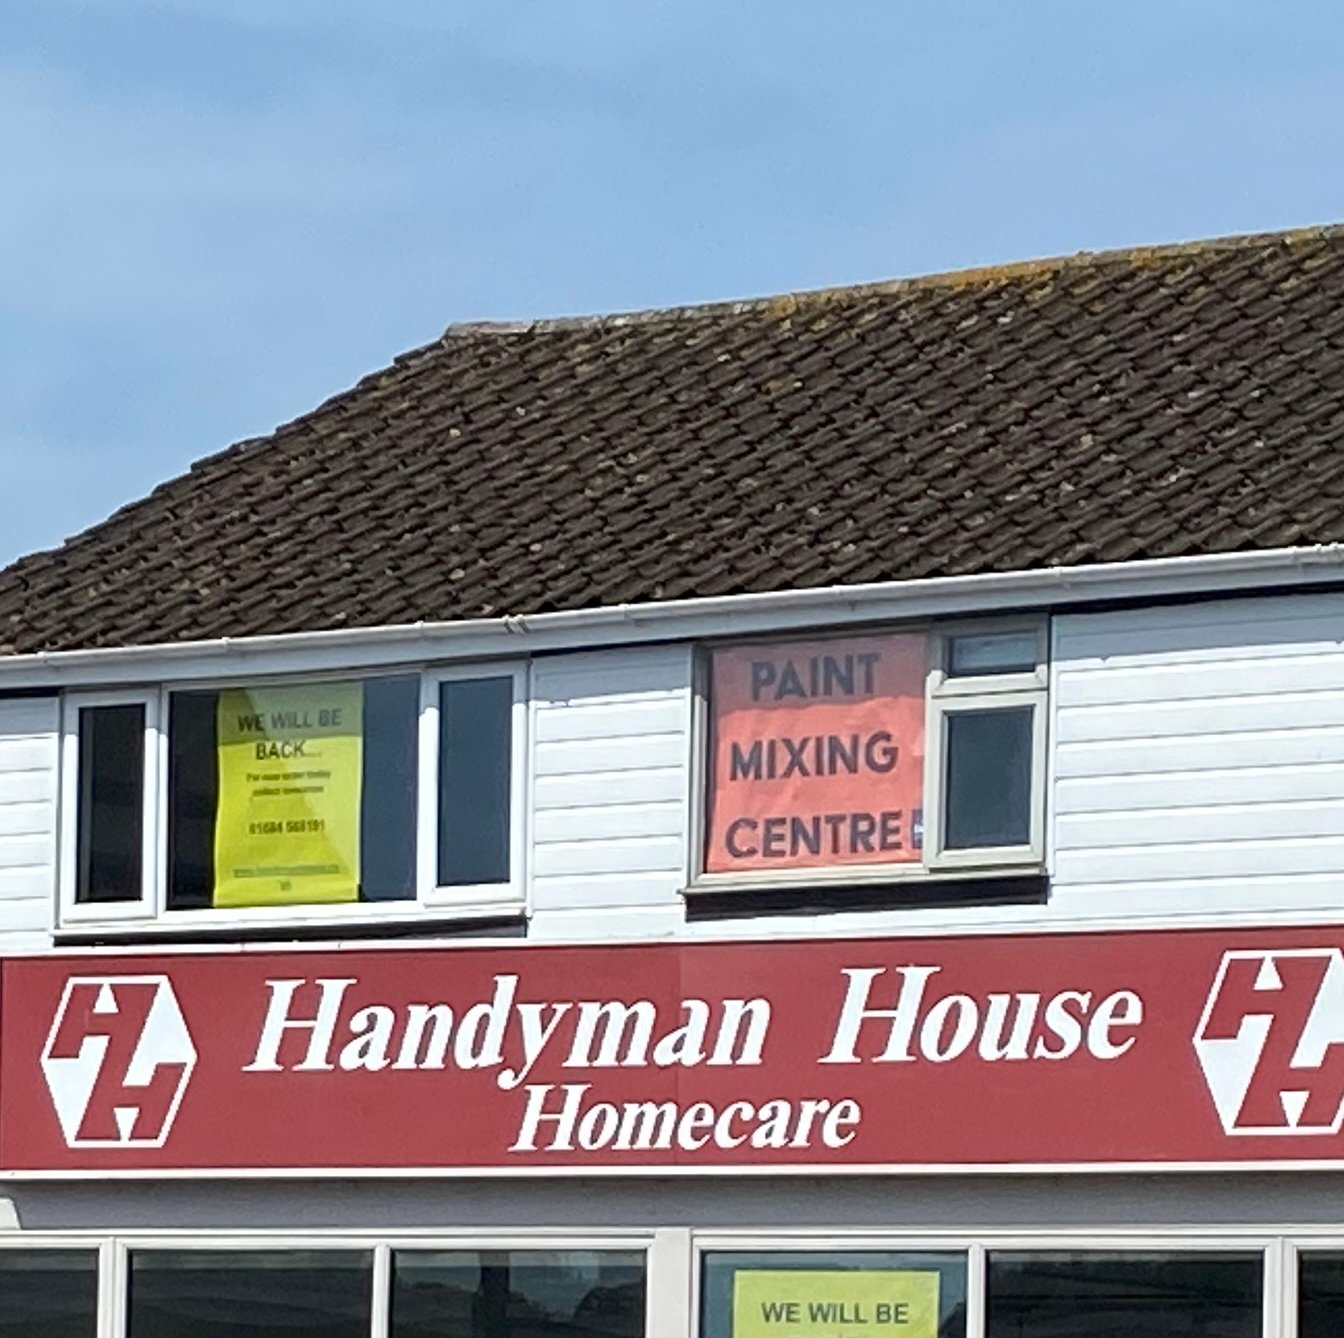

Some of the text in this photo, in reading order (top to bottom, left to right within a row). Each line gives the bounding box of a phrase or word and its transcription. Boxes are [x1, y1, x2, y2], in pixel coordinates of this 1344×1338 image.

[751, 654, 881, 702] PAINT
[237, 708, 343, 732] WE WILL BE
[729, 730, 899, 781] MIXING
[725, 809, 903, 859] CENTRE
[241, 965, 1144, 1090] Handyman House
[507, 1084, 861, 1152] Homecare
[761, 1302, 909, 1324] WE WILL BE
